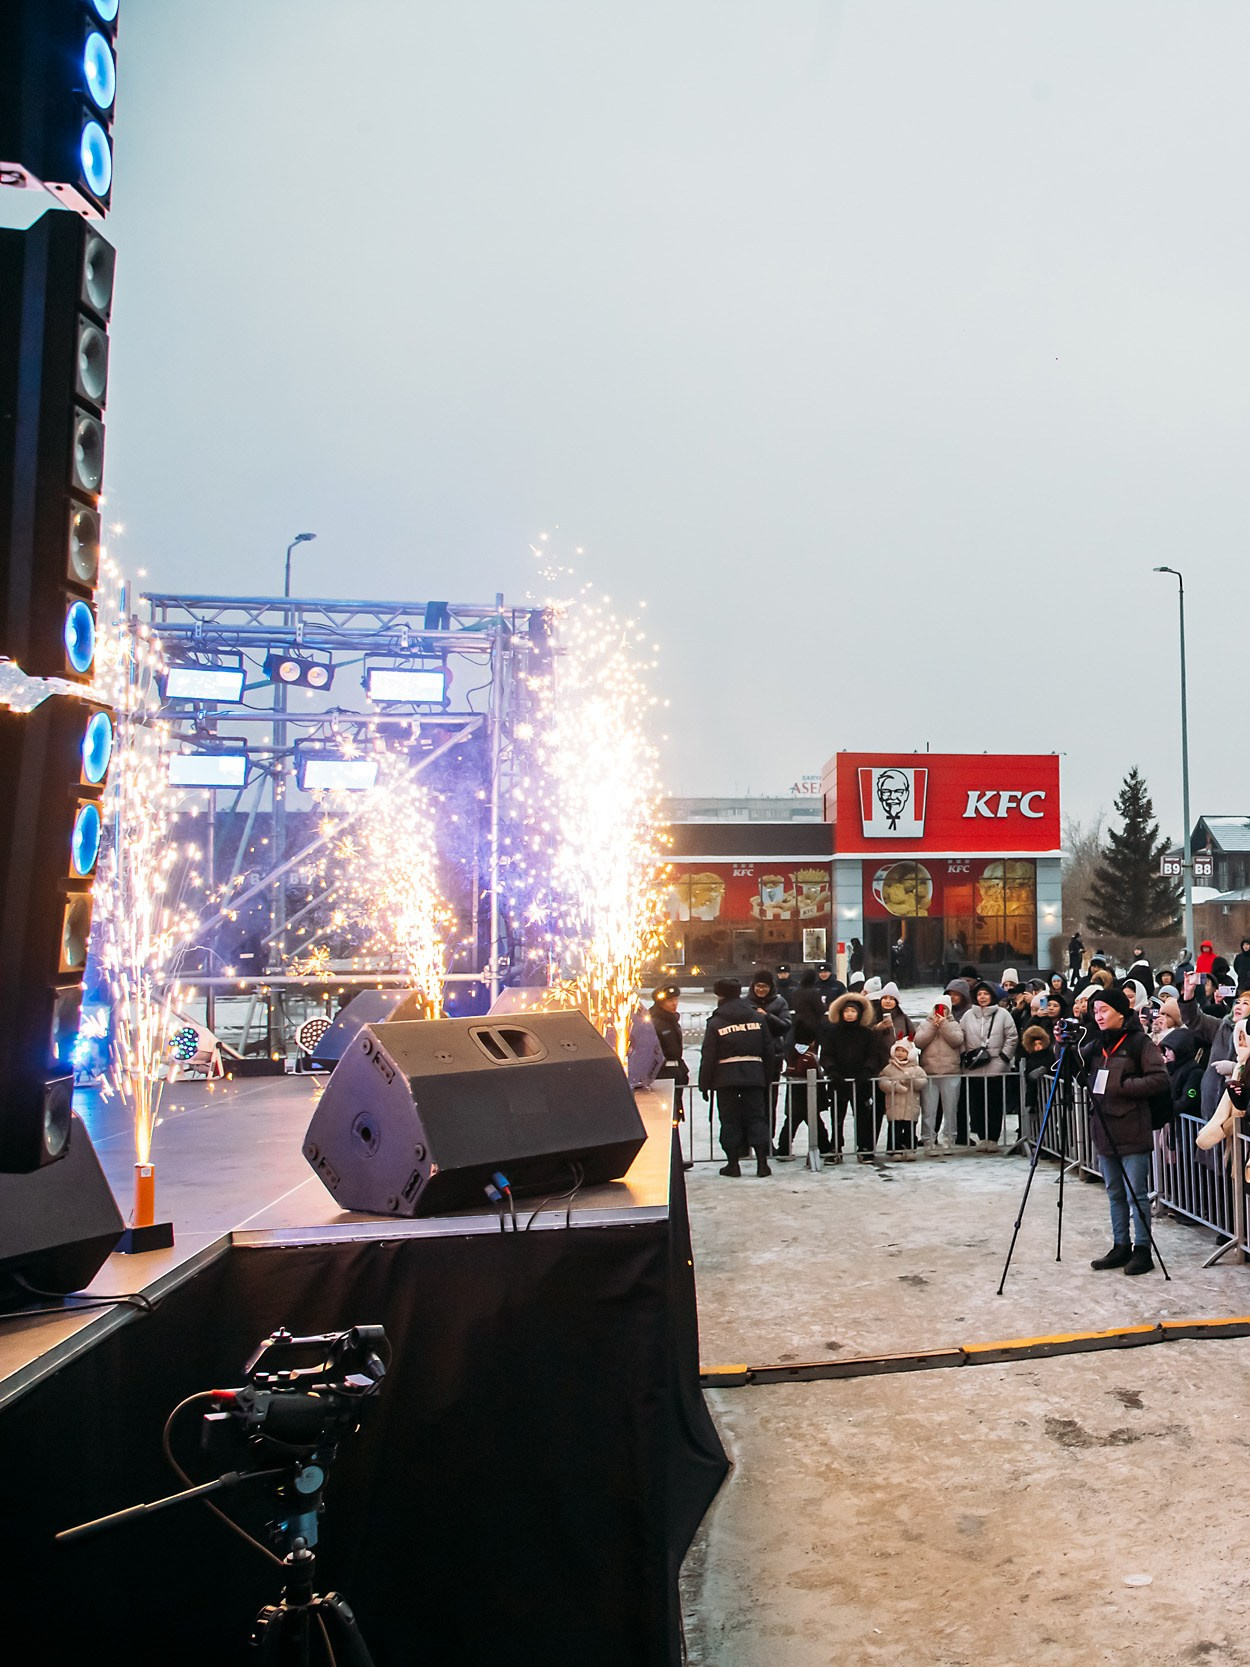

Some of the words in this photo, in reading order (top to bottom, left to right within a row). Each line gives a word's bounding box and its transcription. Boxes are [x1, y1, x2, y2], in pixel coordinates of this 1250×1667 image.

[962, 790, 1046, 819] KFC
[732, 869, 754, 877] KFC
[947, 864, 970, 873] KFC
